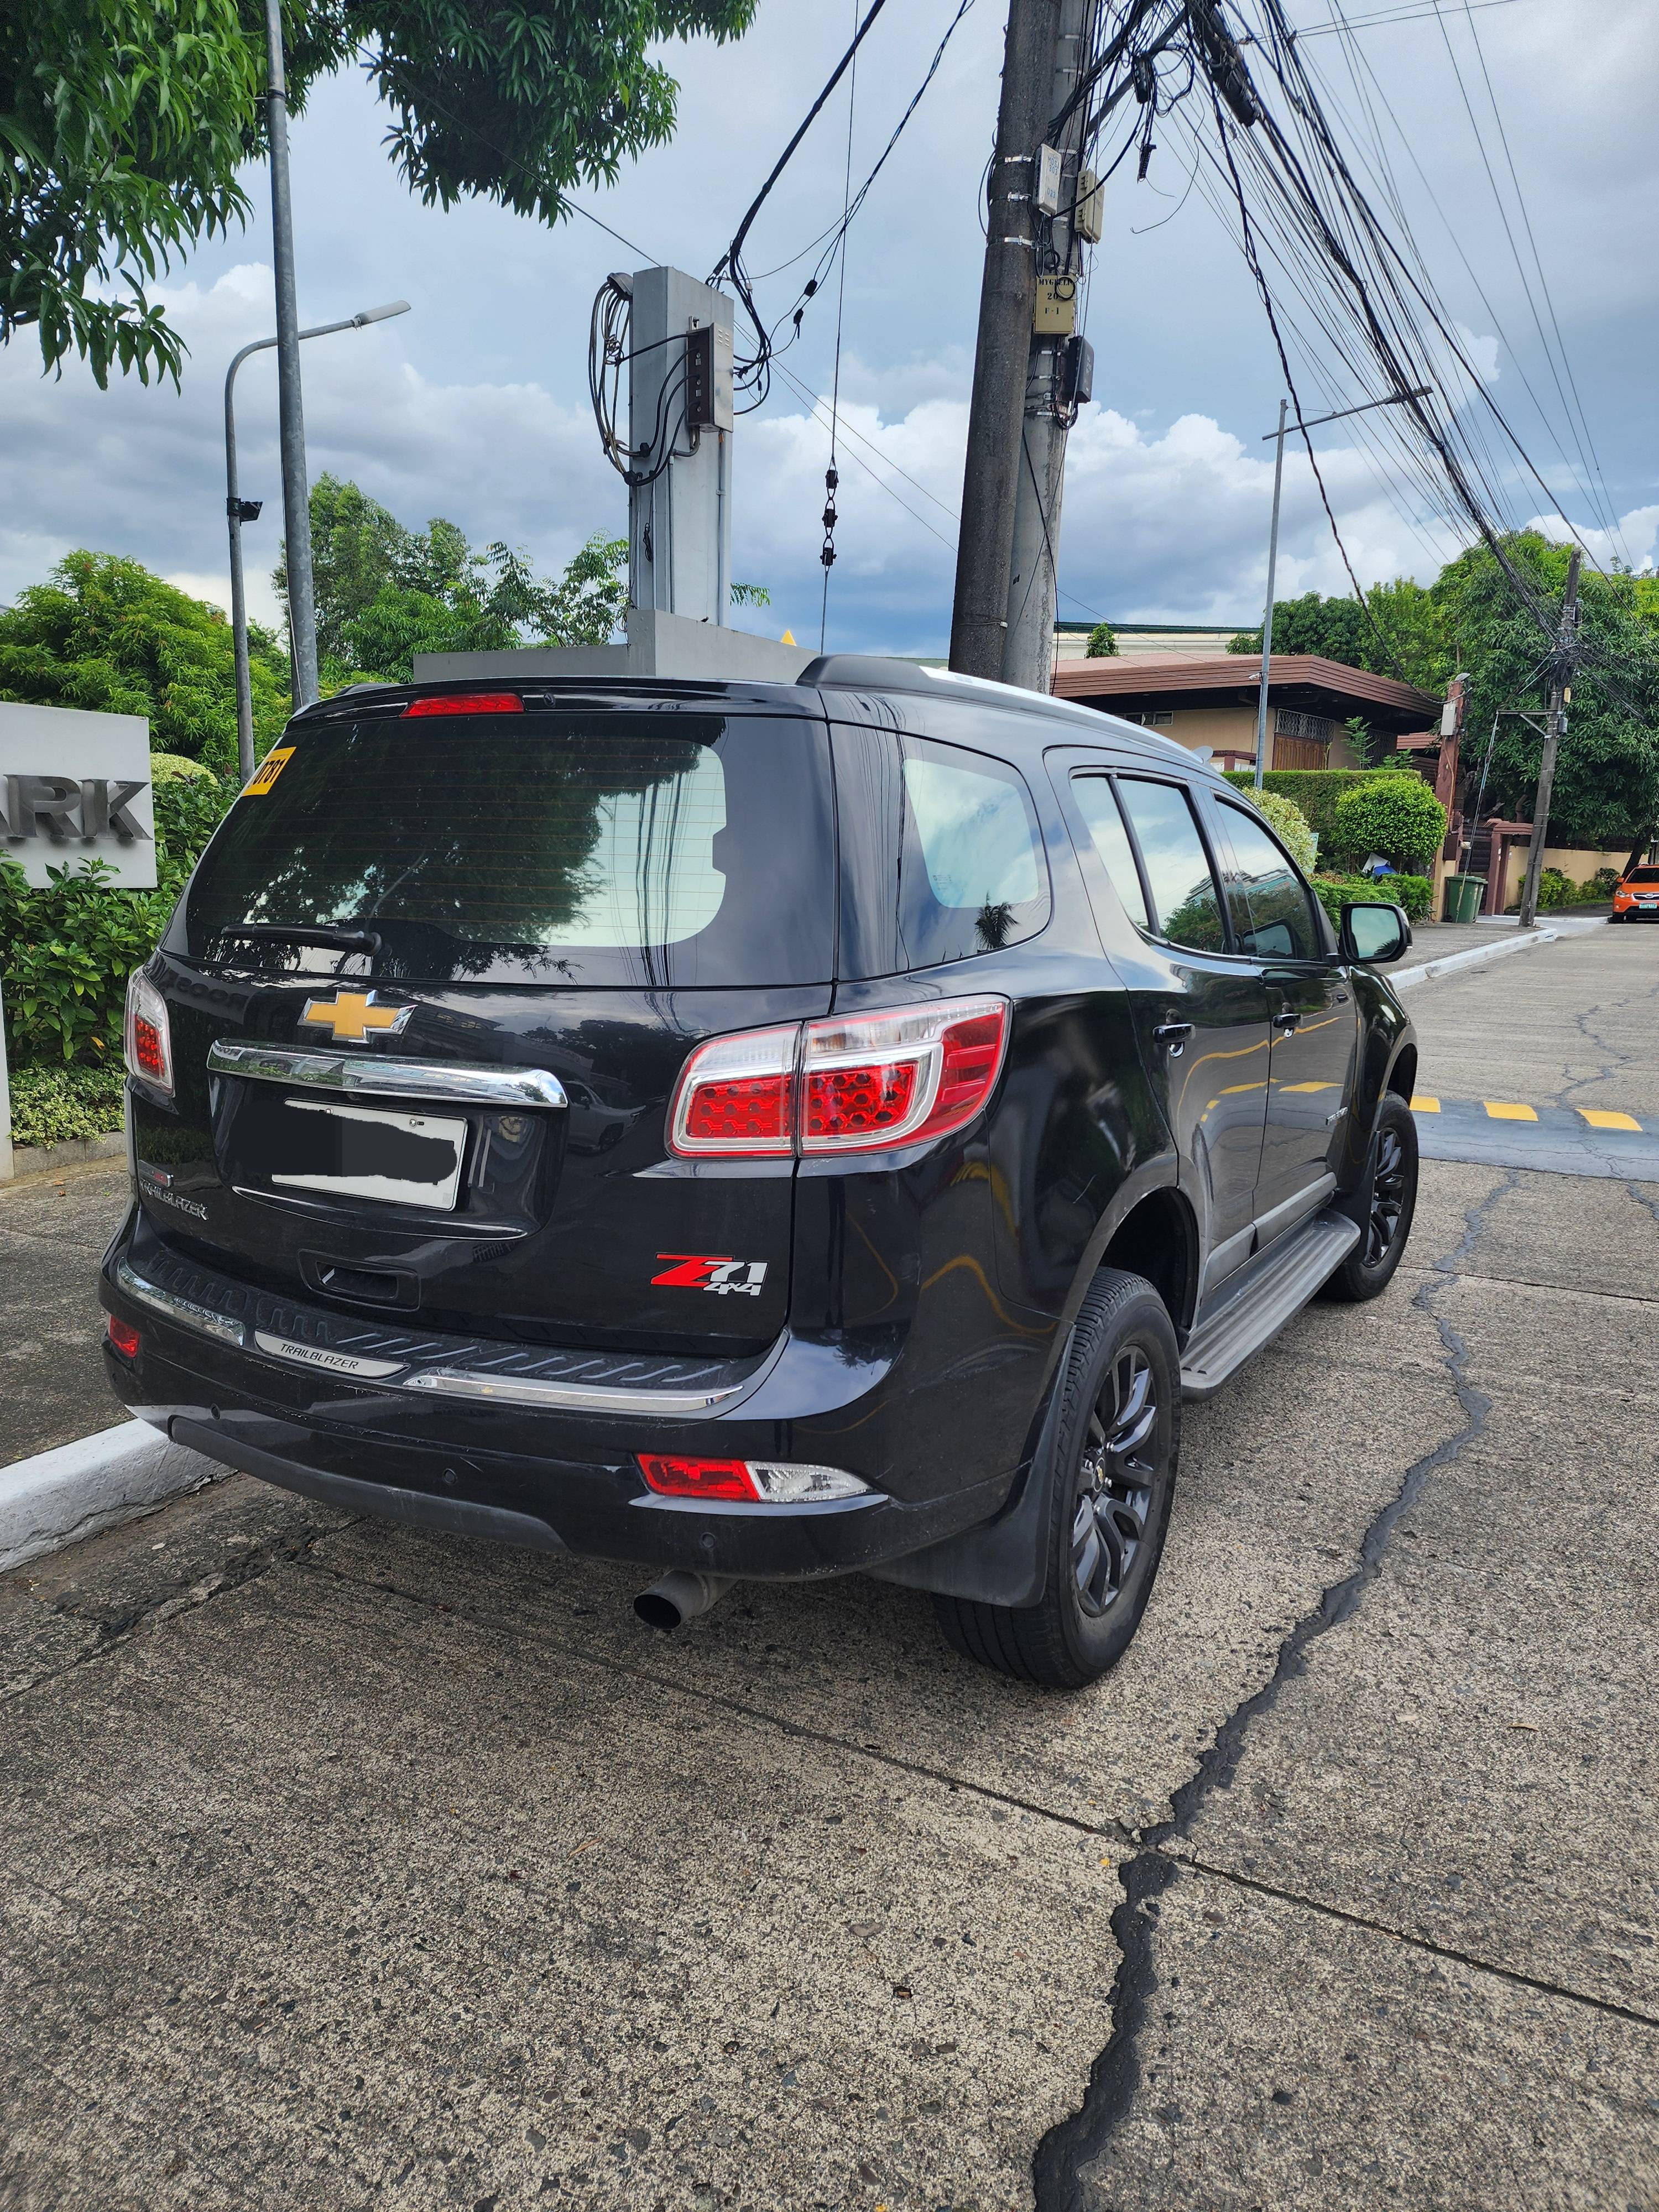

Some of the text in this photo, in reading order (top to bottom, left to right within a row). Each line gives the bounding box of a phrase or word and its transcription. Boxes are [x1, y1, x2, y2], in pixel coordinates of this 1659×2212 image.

[0, 774, 153, 840] RK
[140, 1178, 209, 1220] TRAILBLAZER
[650, 1254, 768, 1287] Z71
[280, 1343, 359, 1369] TRAILBLAZER
